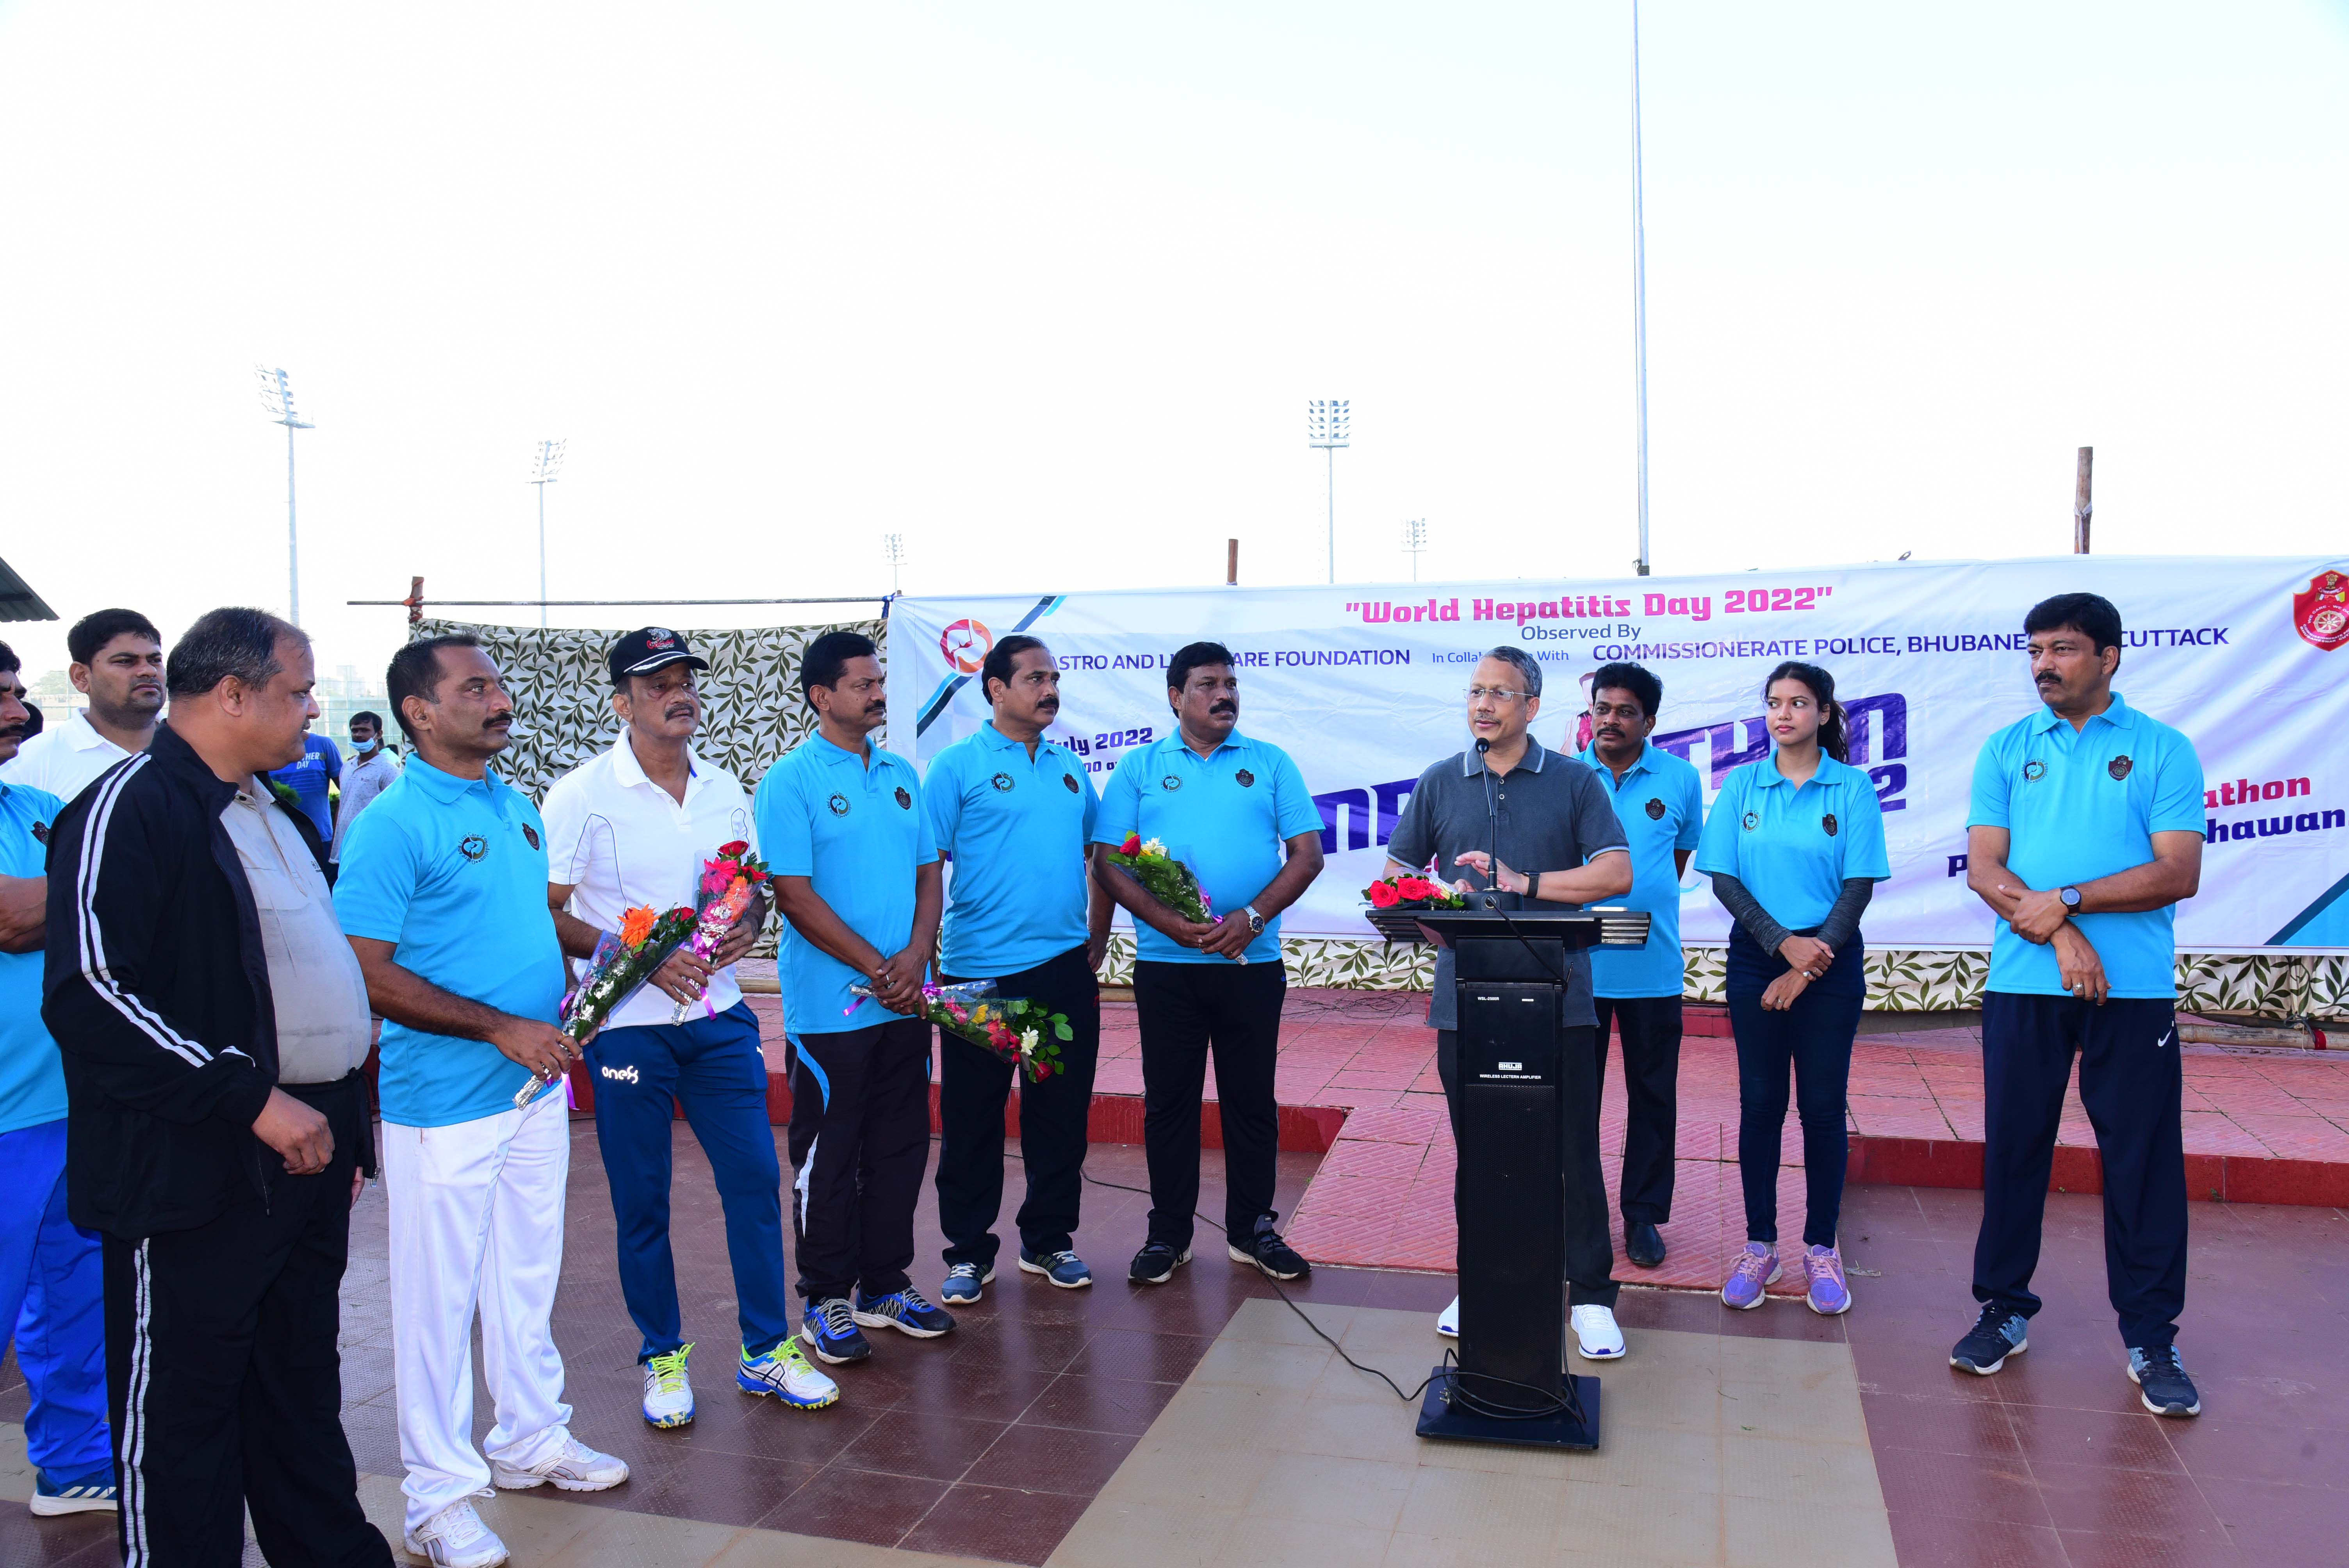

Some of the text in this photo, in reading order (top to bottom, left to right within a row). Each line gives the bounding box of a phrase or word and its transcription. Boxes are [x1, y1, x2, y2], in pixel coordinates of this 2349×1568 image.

[1346, 586, 1832, 626] "World Hepatitis Day 2022"
[2312, 605, 2327, 614] CARE
[1521, 624, 1641, 641] Observed By
[1537, 650, 1569, 661] With
[1593, 633, 2028, 661] COMMISSIONERATE POLICE, BHUBANE
[1052, 655, 1108, 670] STRO
[1112, 654, 1154, 669] AND
[1233, 649, 1410, 667] ARE FOUNDATION
[1432, 653, 1444, 663] In
[1095, 727, 1153, 750] 2022
[296, 760, 310, 770] DAY
[2204, 777, 2310, 809] athon
[2206, 809, 2347, 844] hawan
